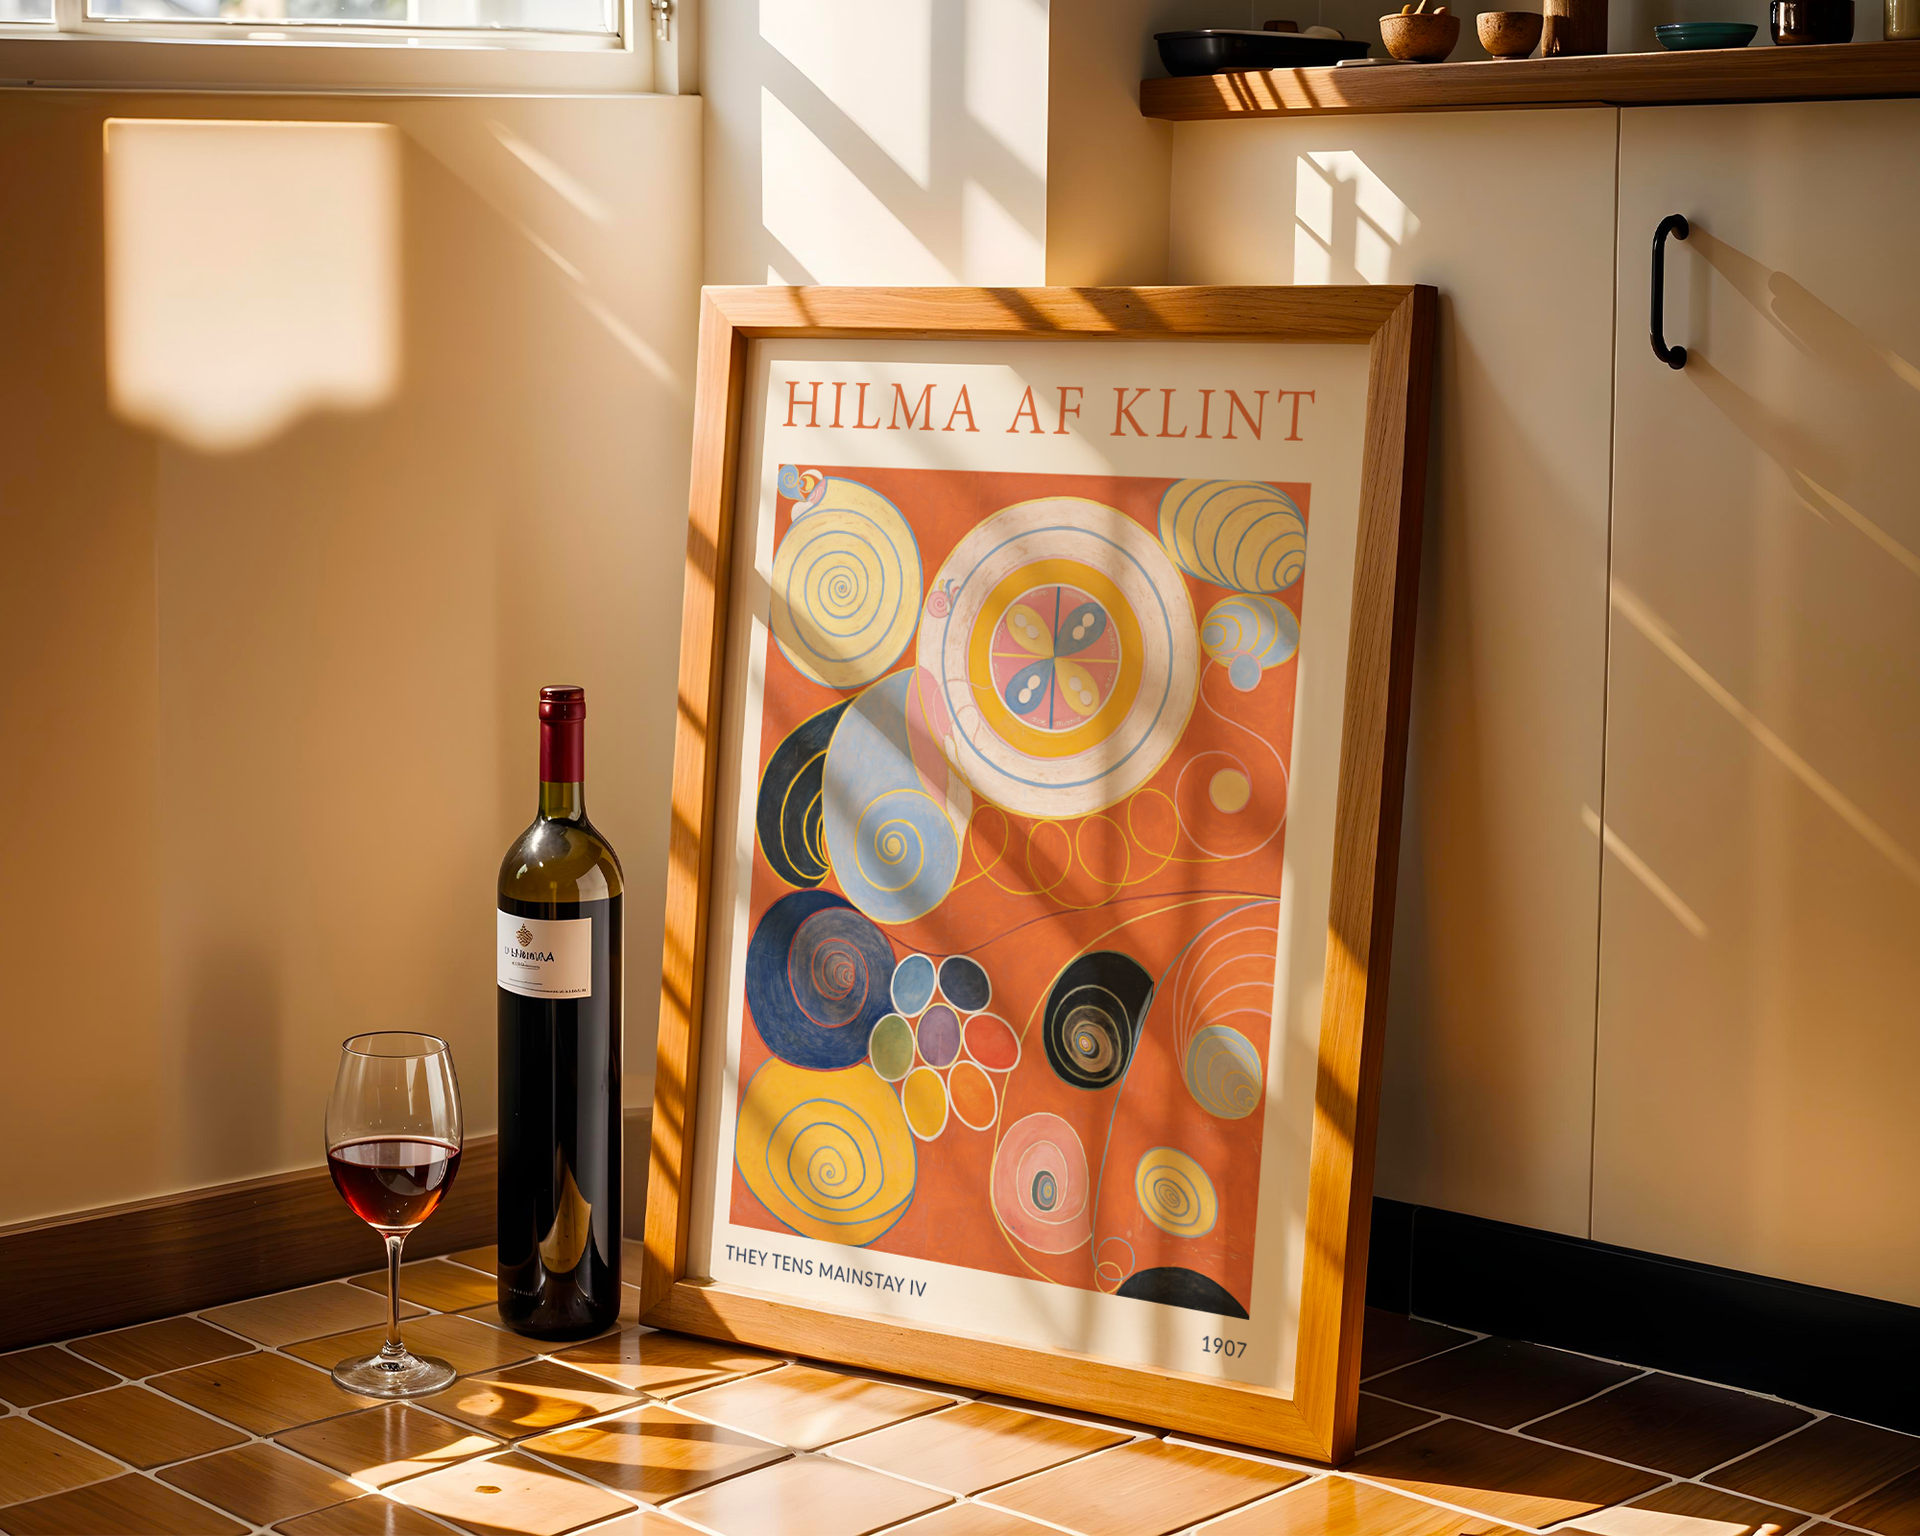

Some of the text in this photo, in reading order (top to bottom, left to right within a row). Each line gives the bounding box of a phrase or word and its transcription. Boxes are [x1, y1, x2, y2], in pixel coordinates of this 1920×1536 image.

[783, 381, 1316, 441] HILMA AF KLINT
[726, 1244, 927, 1297] THEY TENS MAINSTAY IV
[1202, 1335, 1247, 1359] 1907
